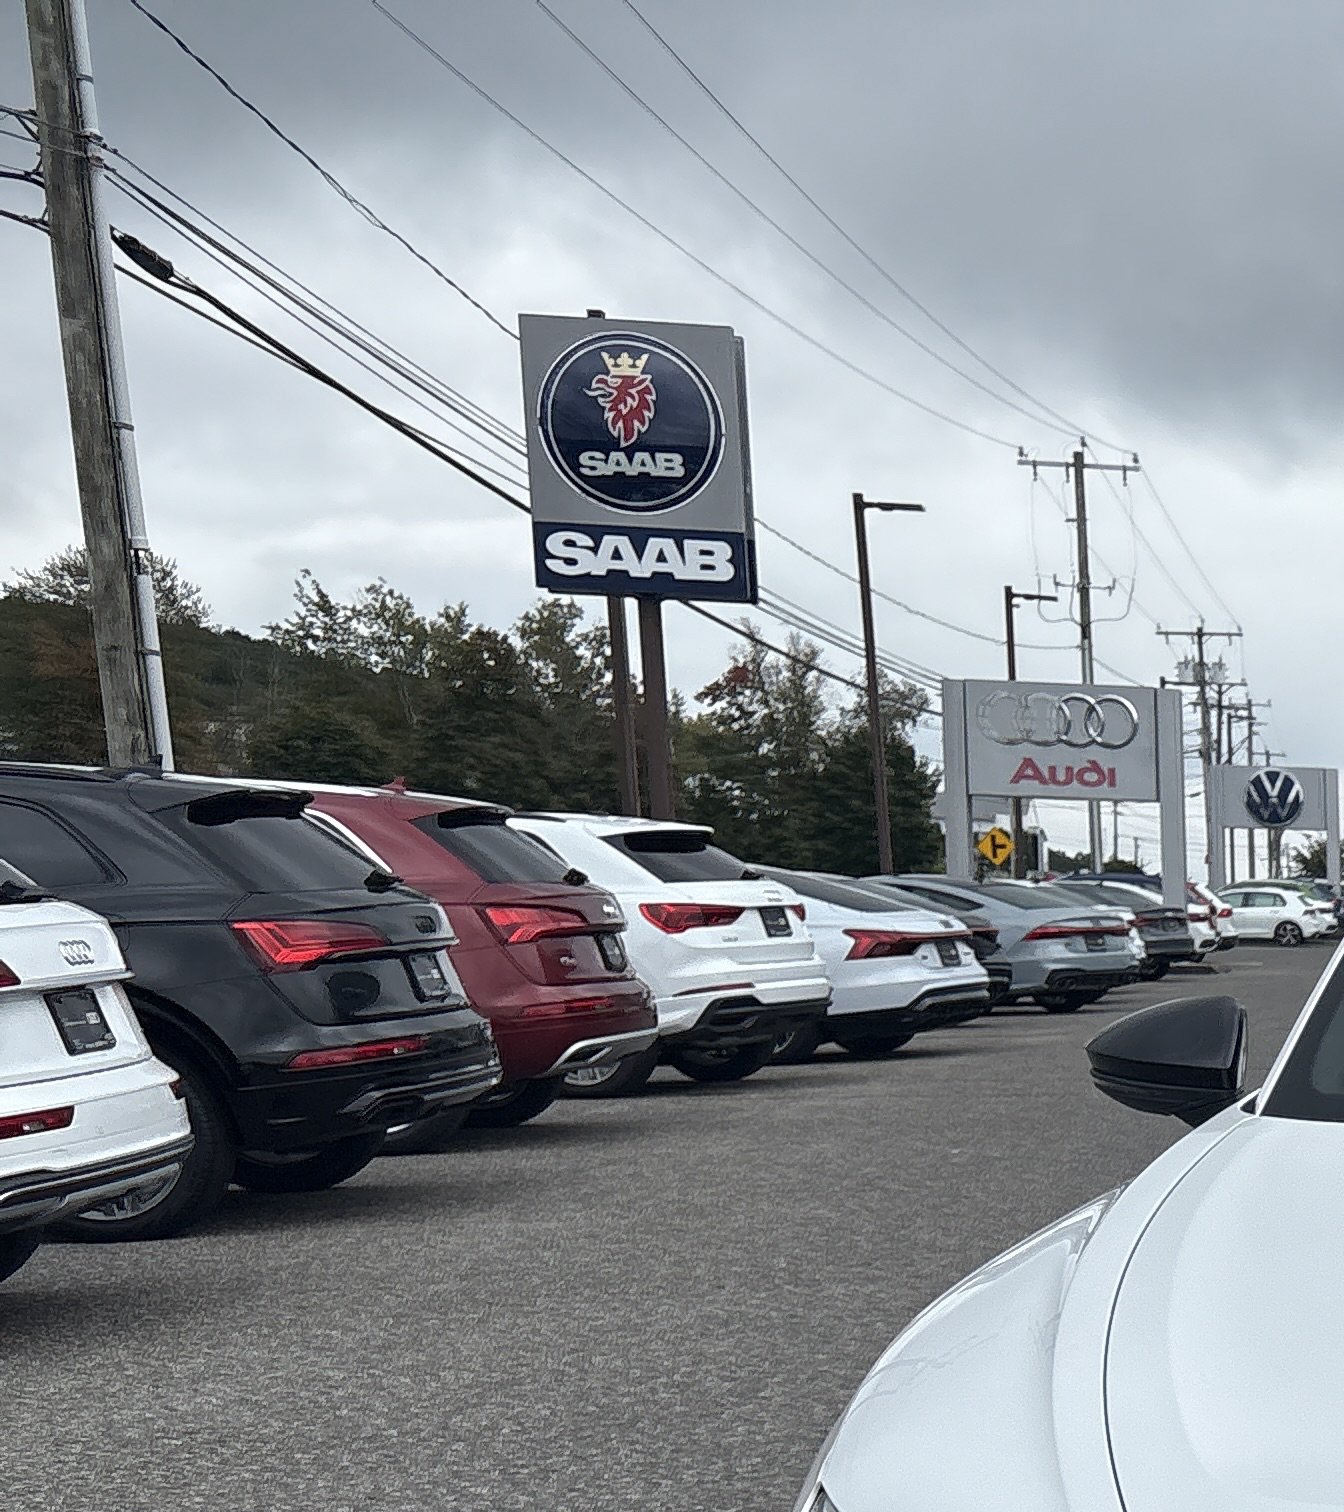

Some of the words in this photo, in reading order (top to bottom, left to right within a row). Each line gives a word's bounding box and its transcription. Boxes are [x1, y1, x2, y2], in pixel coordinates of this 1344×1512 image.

[579, 451, 686, 478] SAAB
[545, 531, 735, 582] SAAB
[1010, 757, 1117, 789] Audi
